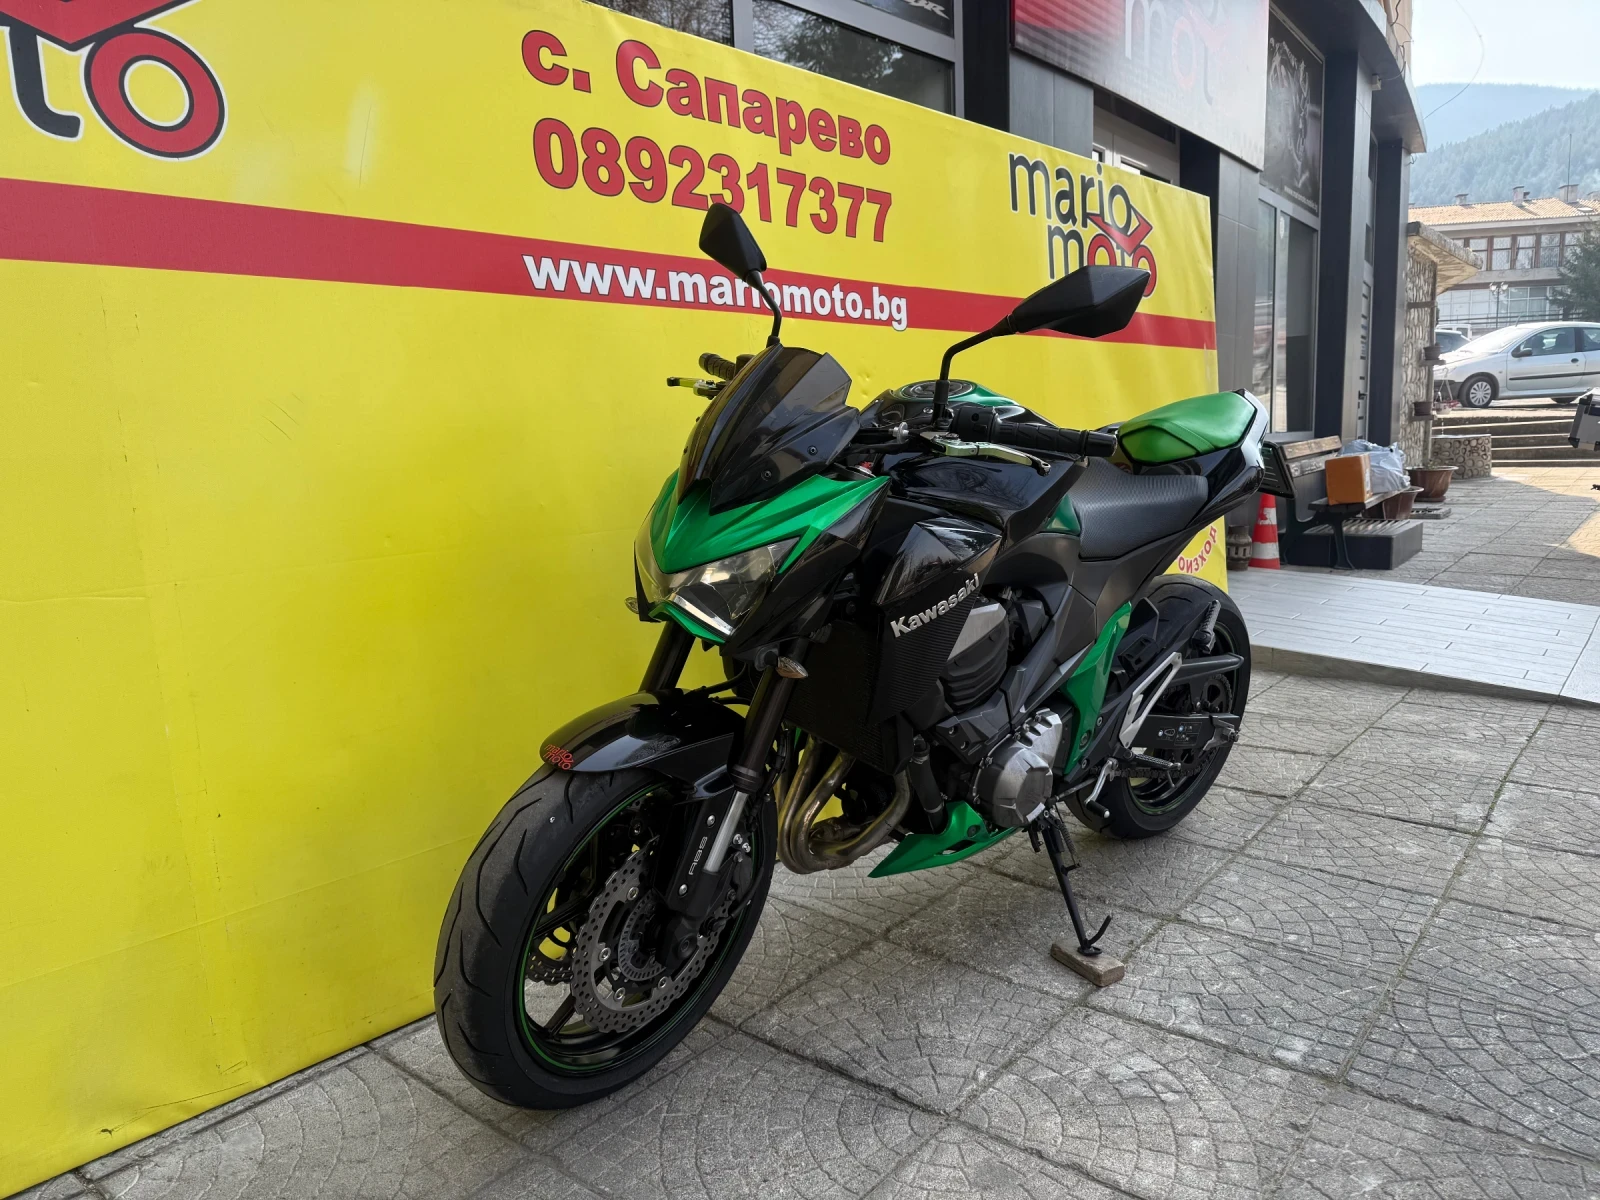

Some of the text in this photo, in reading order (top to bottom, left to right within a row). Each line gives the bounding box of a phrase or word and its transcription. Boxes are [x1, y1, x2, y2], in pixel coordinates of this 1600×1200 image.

[521, 29, 892, 166] с. Сапарево
[532, 117, 893, 243] 0892317377
[1008, 153, 1133, 237] mario
[890, 572, 980, 638] Kawasaki
[542, 751, 572, 771] moto
[543, 743, 573, 761] mario
[688, 836, 708, 876] ABS
